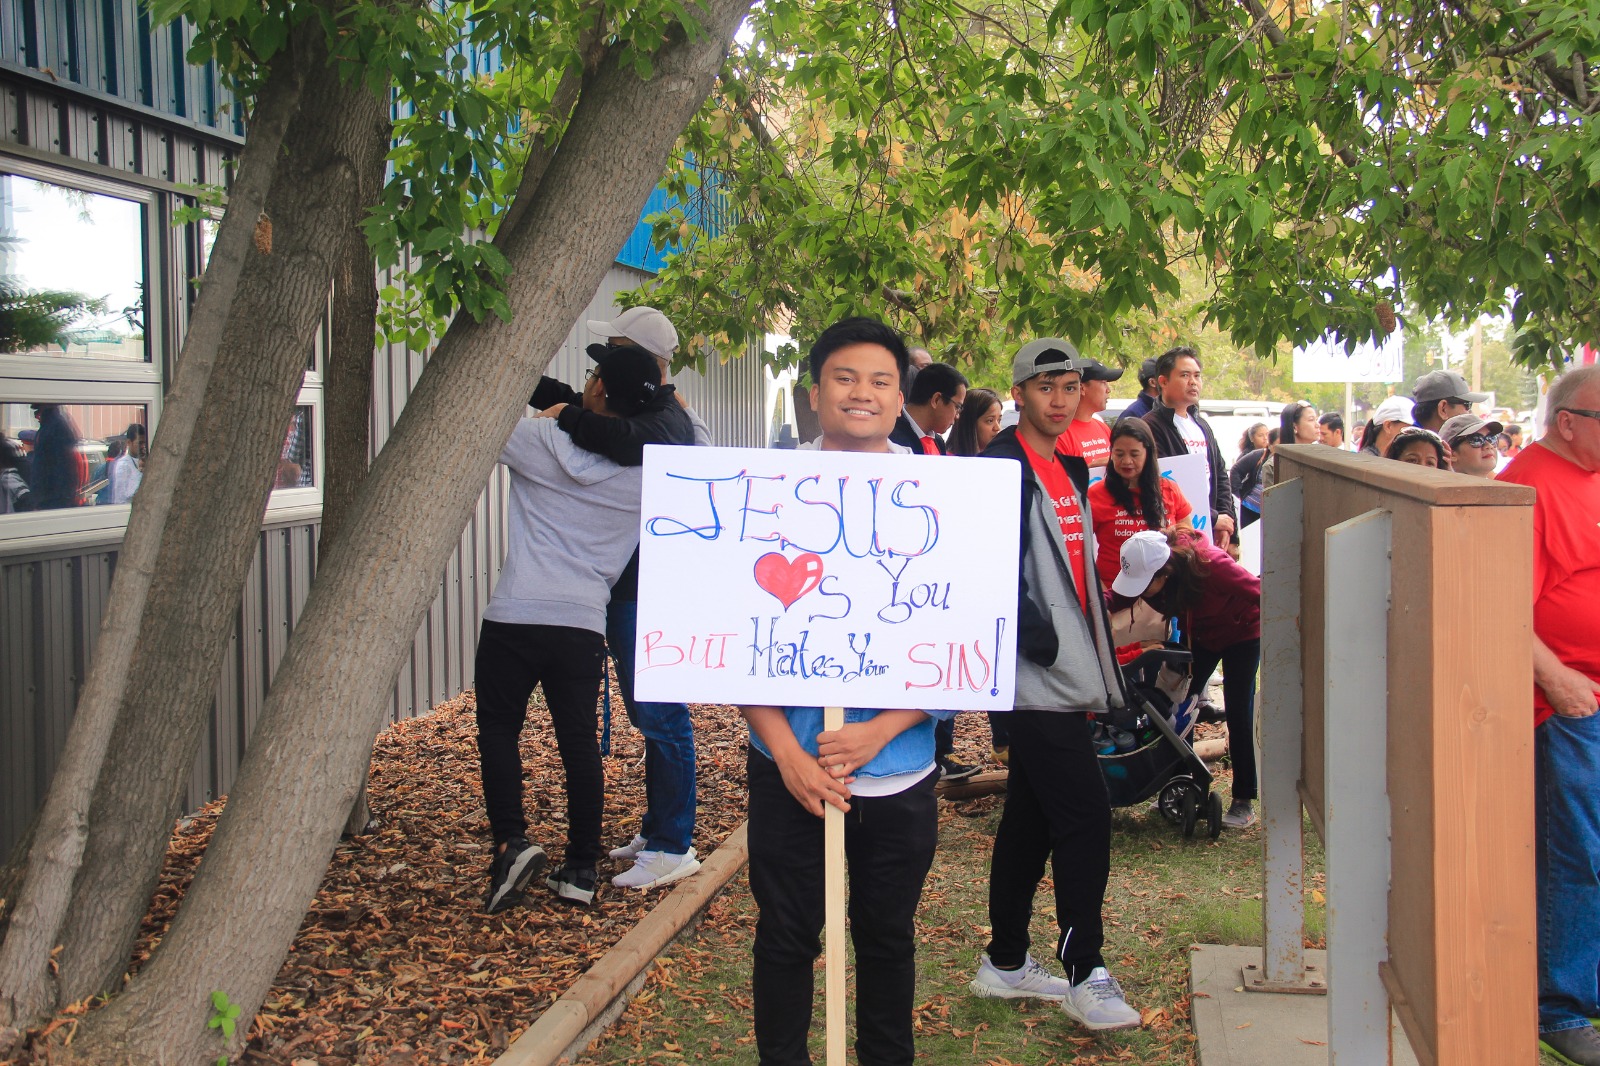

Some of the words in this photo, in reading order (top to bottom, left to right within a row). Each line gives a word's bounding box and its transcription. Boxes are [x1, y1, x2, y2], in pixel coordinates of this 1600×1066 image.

[645, 468, 940, 558] JESUS
[1115, 518, 1134, 526] same
[876, 558, 951, 624] You
[636, 630, 738, 676] BUT
[747, 616, 845, 680] Hates
[905, 617, 1006, 697] SIN!
